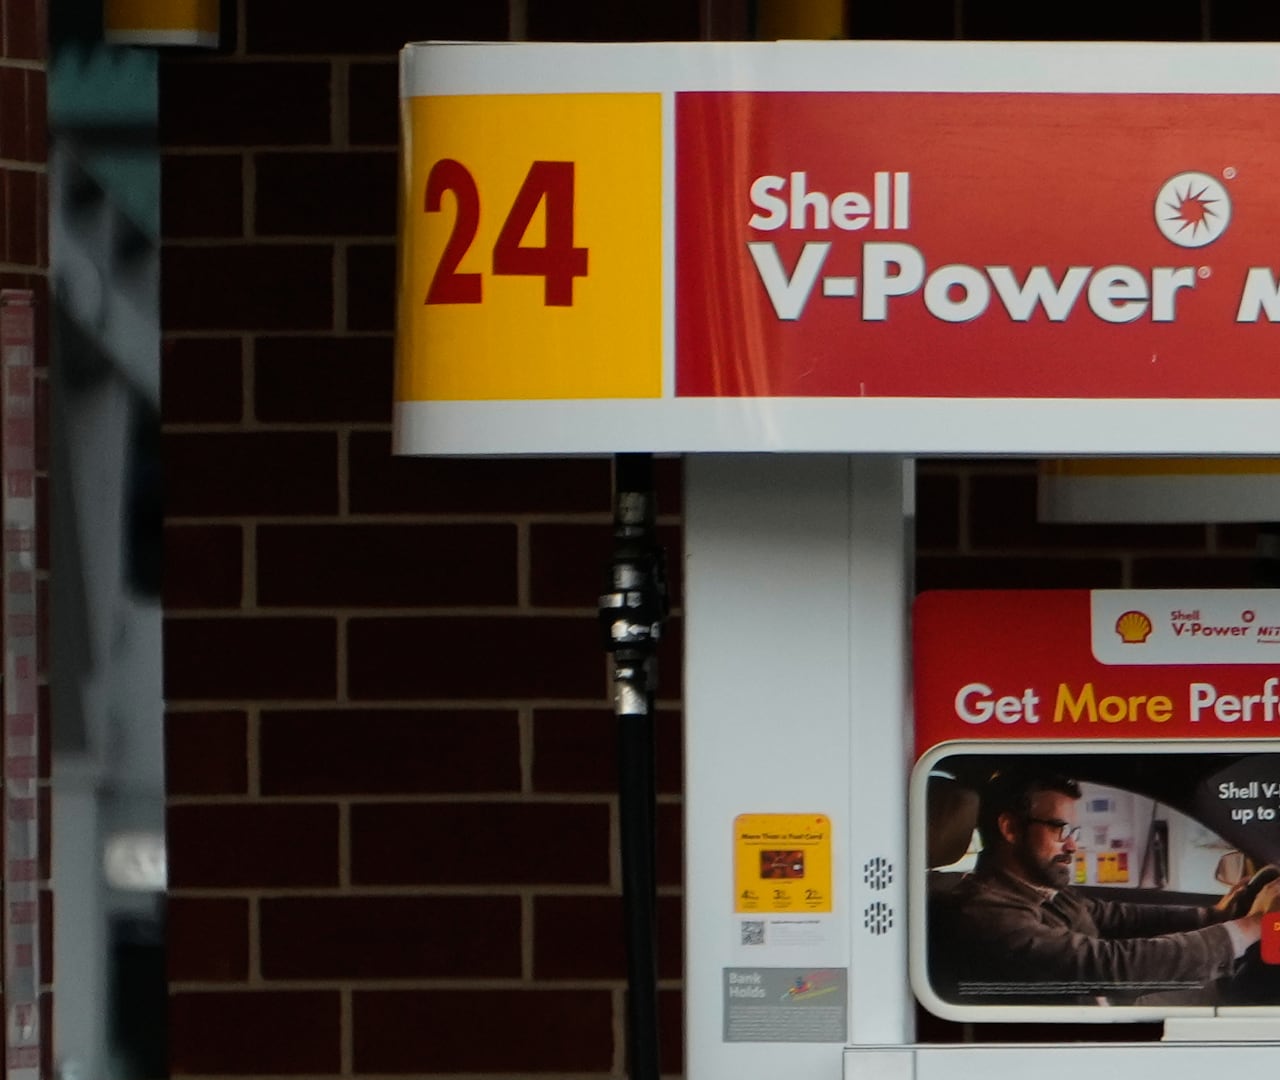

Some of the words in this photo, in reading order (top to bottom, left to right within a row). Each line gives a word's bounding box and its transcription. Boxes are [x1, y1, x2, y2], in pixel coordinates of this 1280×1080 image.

[748, 172, 910, 231] Shell
[424, 158, 588, 308] 24
[1171, 611, 1199, 621] Shell
[955, 683, 1039, 725] Get
[1054, 684, 1172, 724] More
[1218, 783, 1258, 800] Shell
[1232, 808, 1252, 821] up
[1258, 805, 1275, 820] to
[729, 971, 762, 984] Bank
[729, 986, 766, 998] Holds
